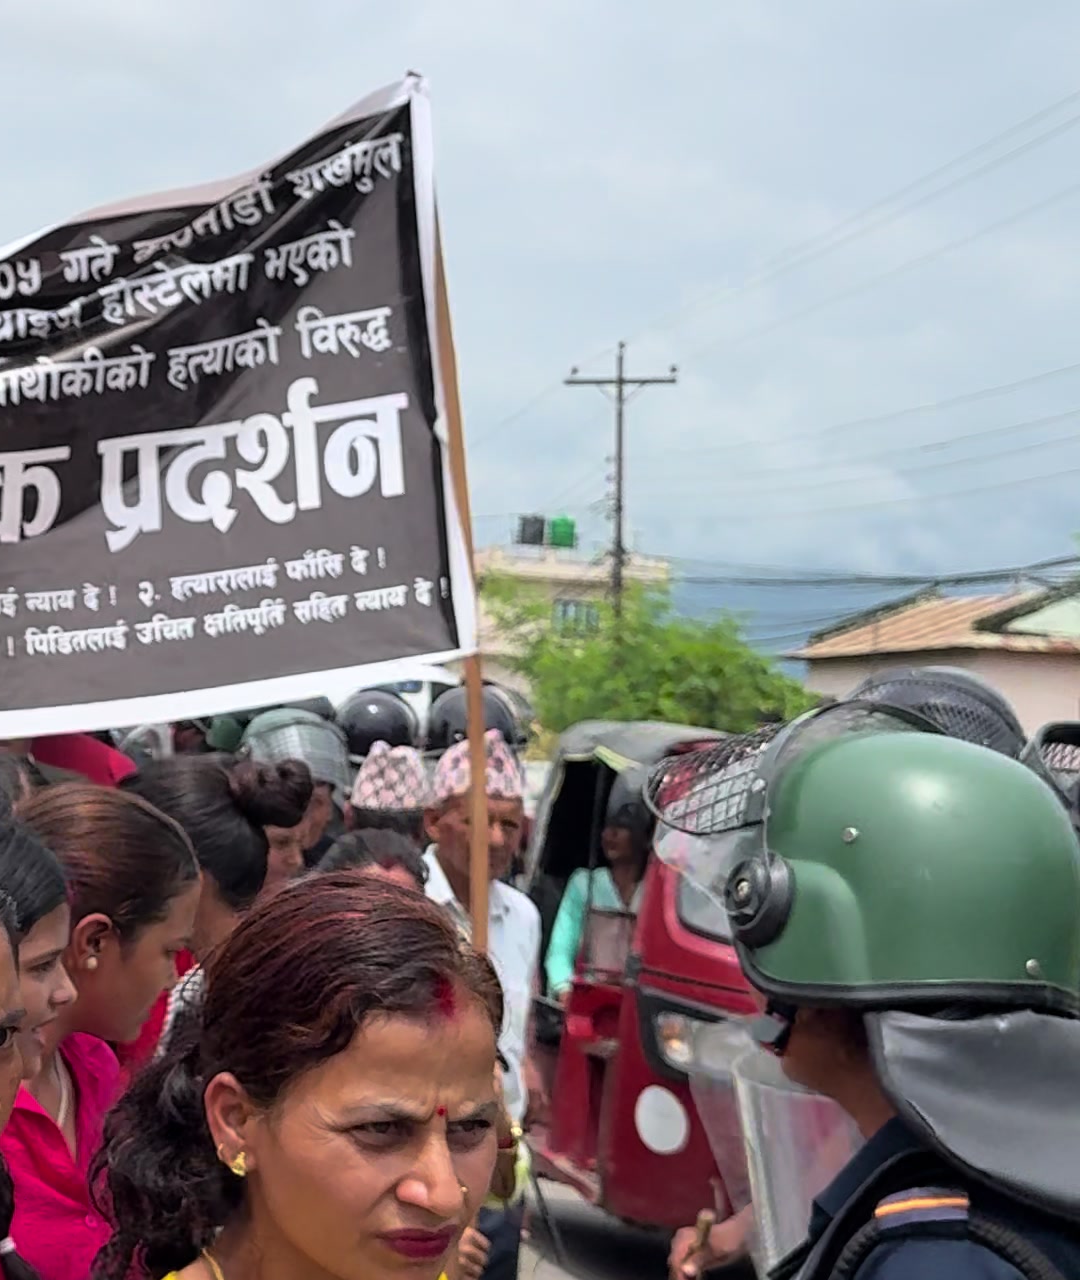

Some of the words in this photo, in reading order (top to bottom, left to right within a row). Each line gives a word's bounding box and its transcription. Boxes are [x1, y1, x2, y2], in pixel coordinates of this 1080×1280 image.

[60, 235, 120, 283] गते
[265, 219, 356, 287] भएको
[167, 317, 282, 390] हत्याको
[295, 306, 392, 357] विरुद्ध
[98, 376, 410, 552] प्रदर्शन
[25, 588, 76, 612] न्याय
[170, 557, 279, 601] हत्यारालाई
[134, 613, 197, 646] उचित
[292, 591, 349, 624] सहित
[354, 585, 408, 612] न्याय
